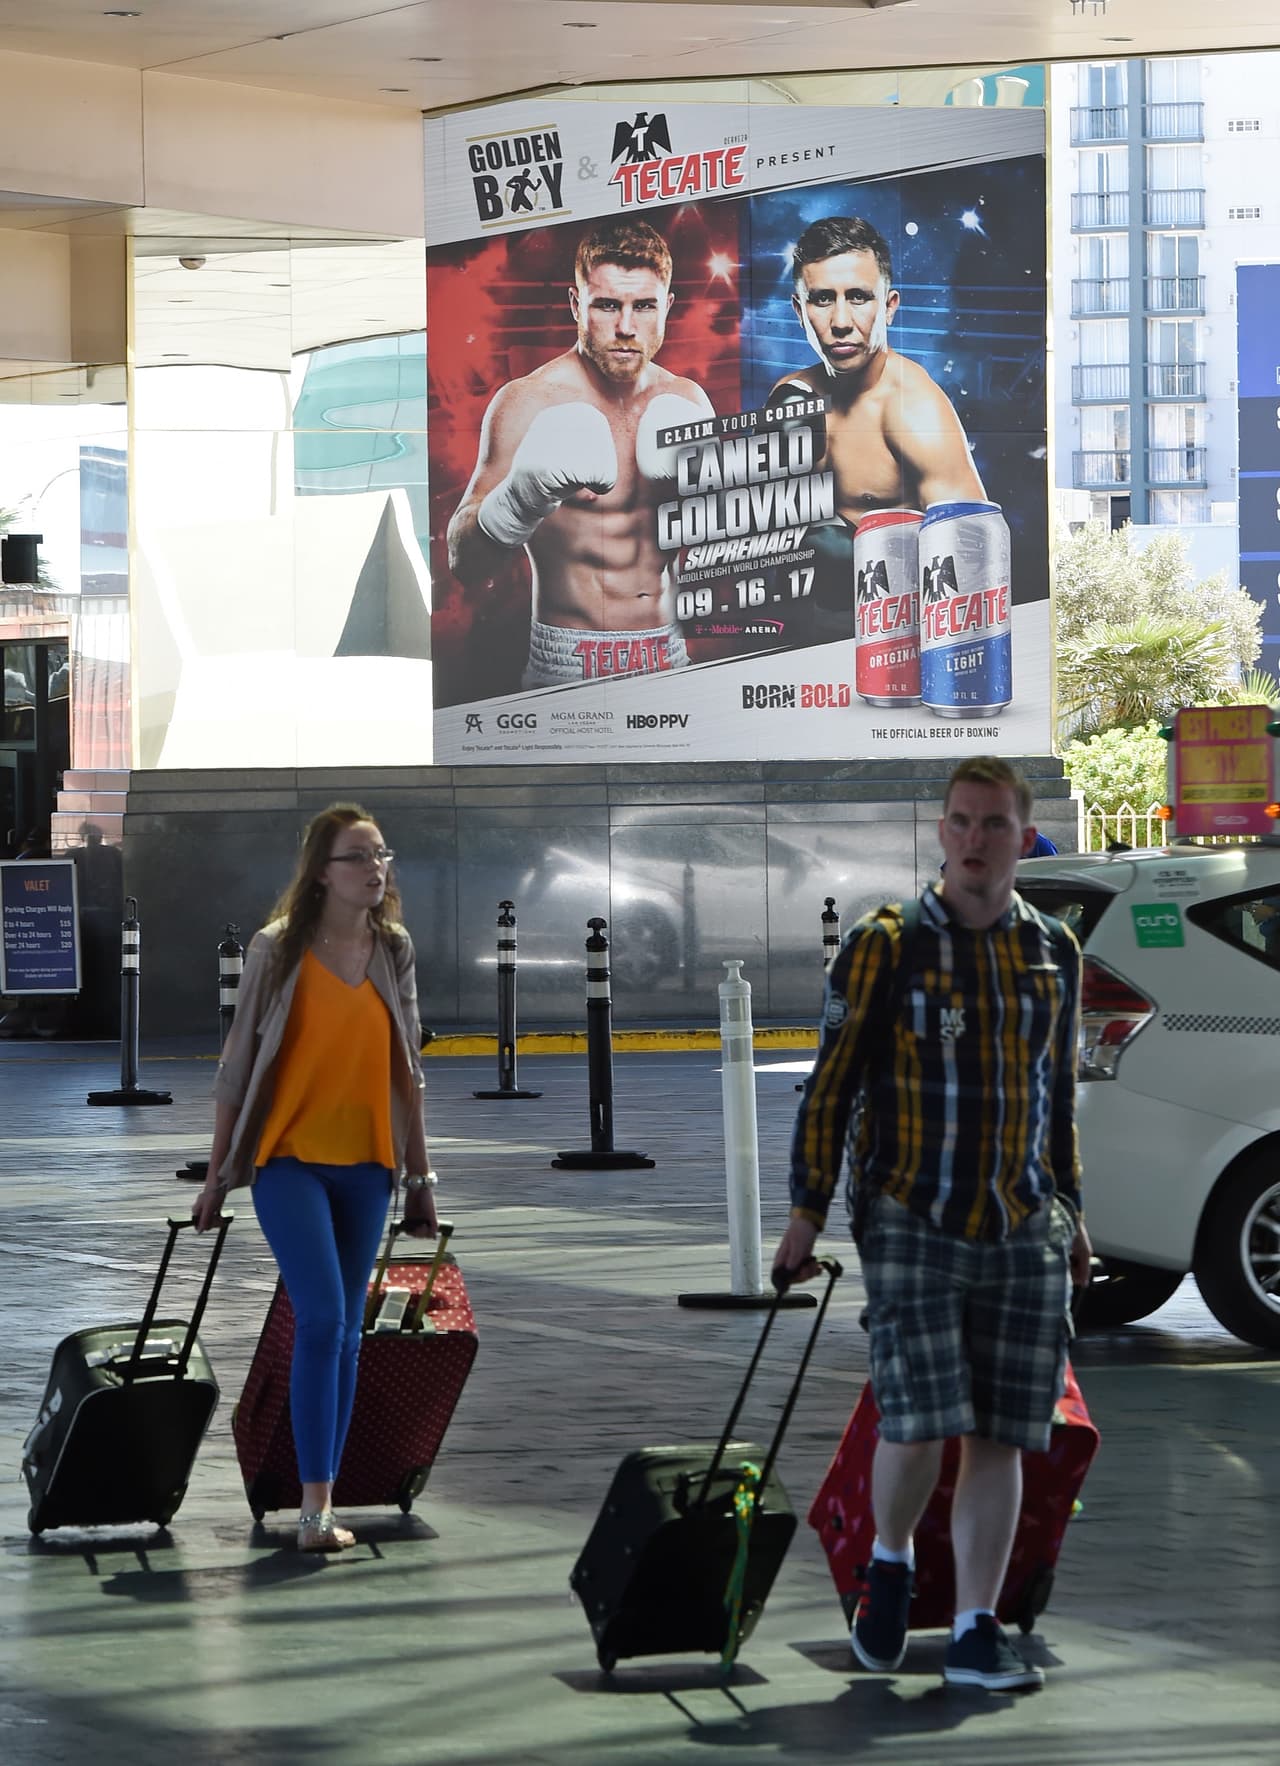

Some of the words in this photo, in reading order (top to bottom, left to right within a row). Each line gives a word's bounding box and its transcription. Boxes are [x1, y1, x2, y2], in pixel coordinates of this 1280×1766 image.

[468, 131, 562, 173] GOLDEN
[757, 145, 836, 169] PRESENT
[577, 156, 598, 180] &
[608, 145, 748, 207] TECATE
[664, 421, 714, 444] CLAIM
[722, 413, 758, 433] YOUR
[765, 399, 825, 422] CORNER
[677, 425, 813, 497] CANELO
[657, 471, 835, 550] GOLOVKIN
[684, 526, 808, 571] SUPREMACY
[677, 565, 731, 584] MIDDLEWEIGHT
[733, 560, 758, 575] WORLD
[760, 549, 815, 568] CHAMPIONSHIP
[857, 591, 920, 640] TECAT
[922, 585, 1009, 643] TECATE
[744, 626, 777, 634] ARENA
[572, 634, 672, 681] TECATE
[946, 651, 985, 673] LIGHT
[742, 685, 795, 709] BORN
[801, 684, 851, 708] BOLD
[497, 713, 537, 729] GGG
[550, 712, 576, 721] MGM
[577, 711, 614, 720] GRAND
[550, 727, 576, 735] OFFICIAL
[871, 728, 888, 739] THE
[890, 728, 928, 739] OFFICIAL
[929, 728, 951, 739] BEER
[954, 727, 965, 738] OF
[967, 727, 999, 738] BOXING
[24, 880, 49, 892] VALET
[5, 906, 25, 914] Parking
[1136, 914, 1178, 927] curb
